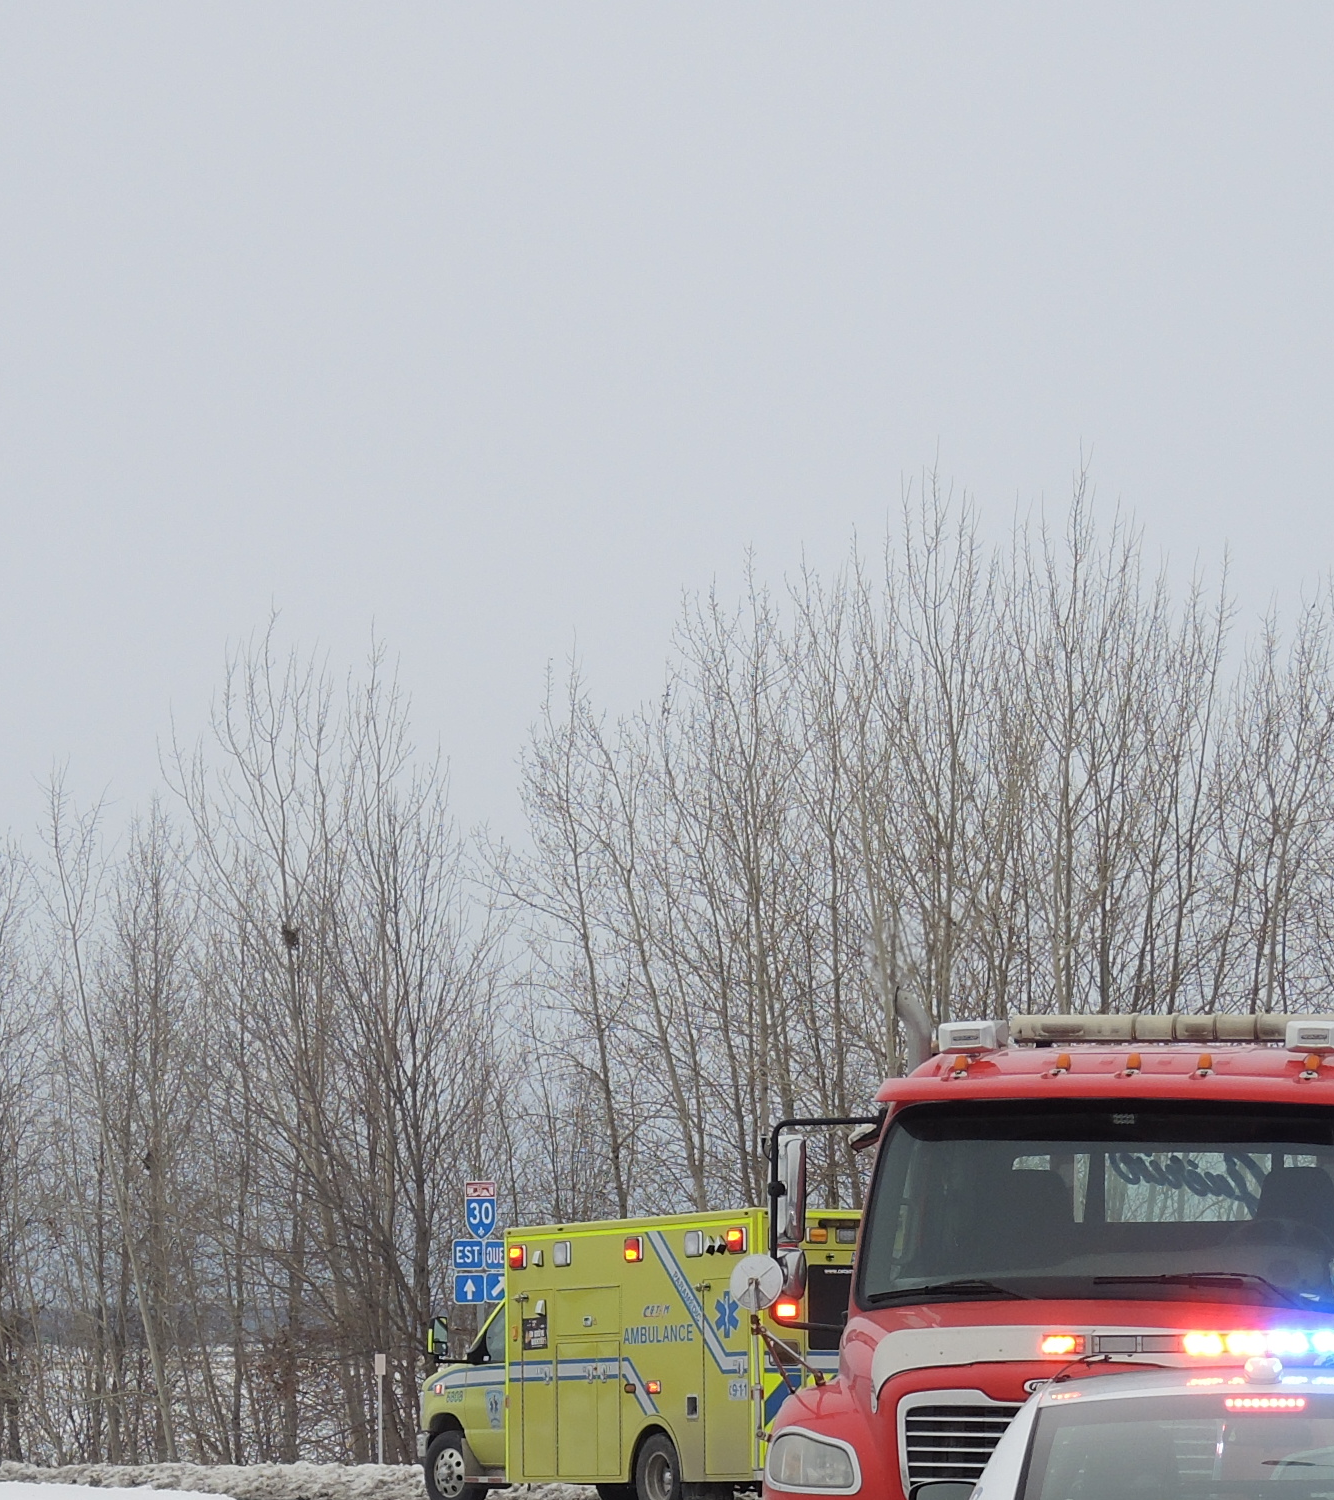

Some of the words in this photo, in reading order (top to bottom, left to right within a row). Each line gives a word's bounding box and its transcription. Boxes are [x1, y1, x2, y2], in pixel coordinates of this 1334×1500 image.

[469, 1202, 492, 1224] 30
[456, 1246, 480, 1263] EST
[487, 1247, 504, 1264] OUE
[623, 1323, 694, 1344] AMBULANCE
